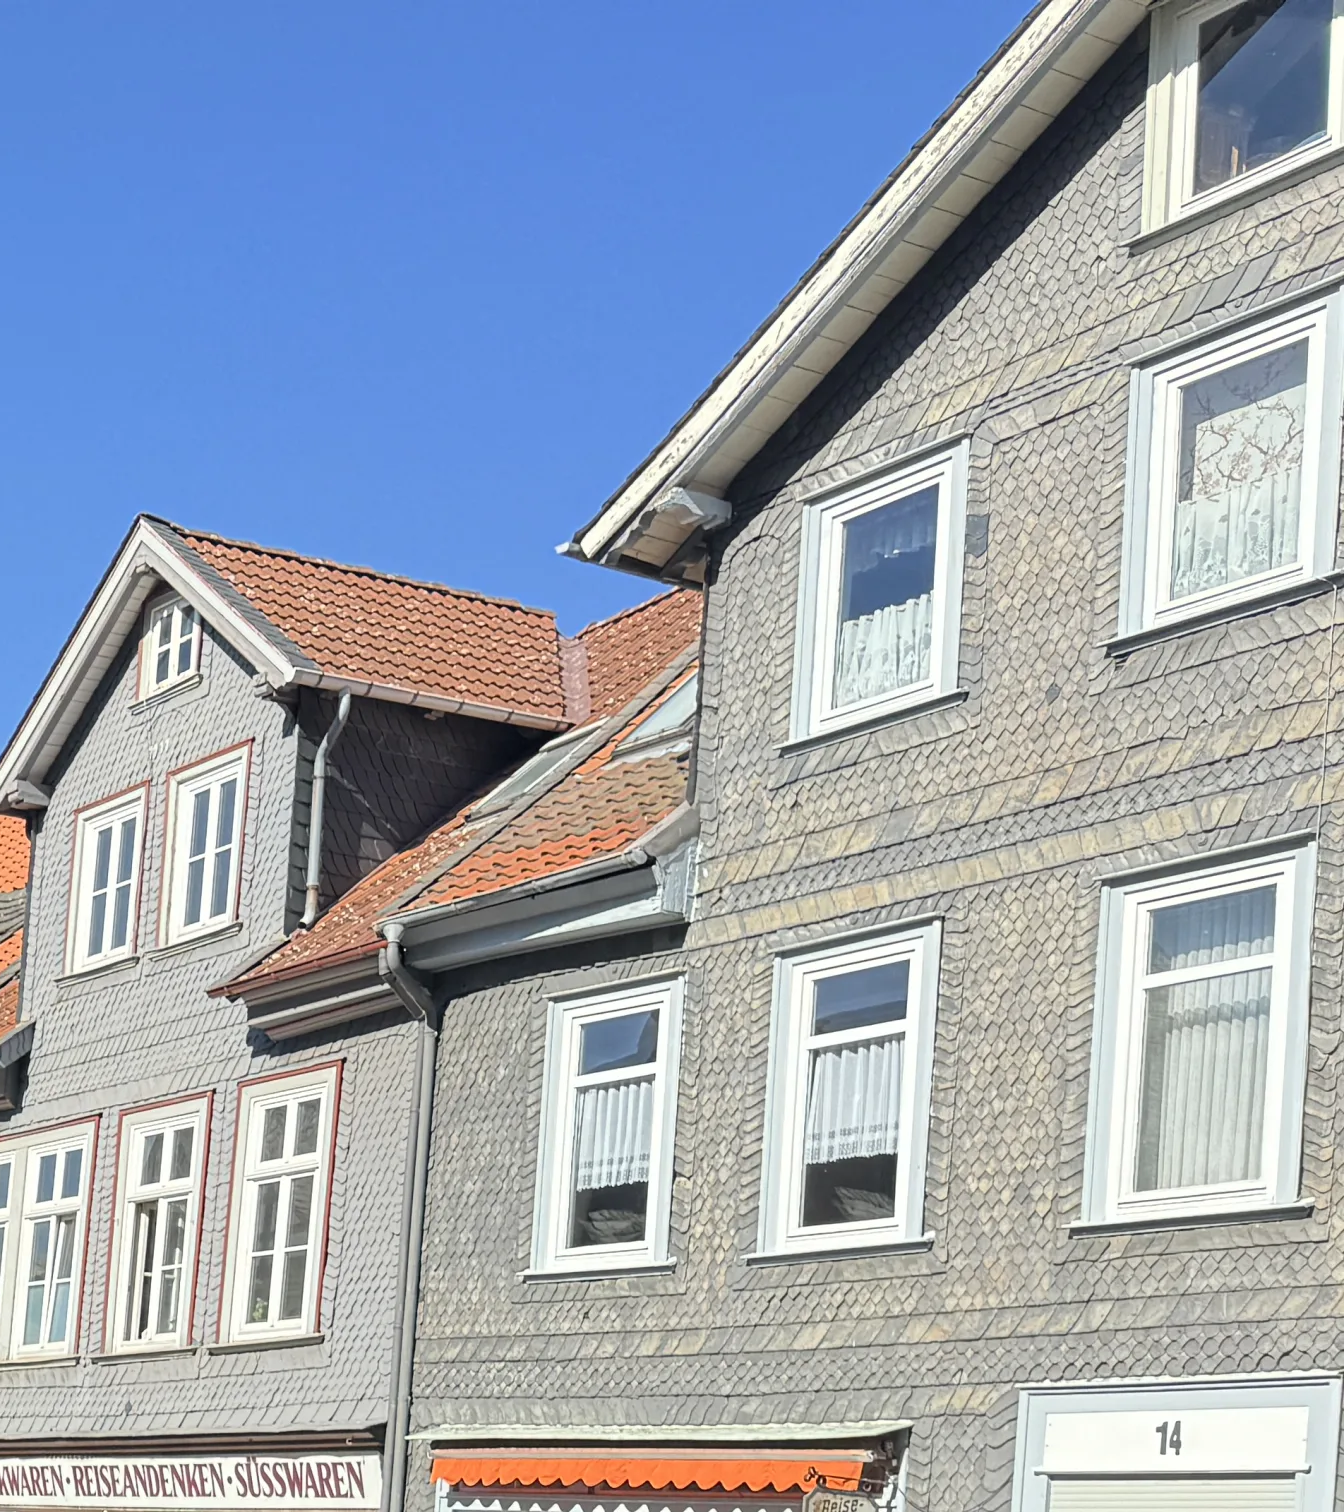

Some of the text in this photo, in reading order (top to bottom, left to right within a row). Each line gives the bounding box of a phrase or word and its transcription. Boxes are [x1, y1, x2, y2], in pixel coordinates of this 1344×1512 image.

[1156, 1420, 1182, 1456] 14
[71, 1463, 226, 1498] REISEANDENKEN
[234, 1455, 366, 1499] SÜSSWAREN
